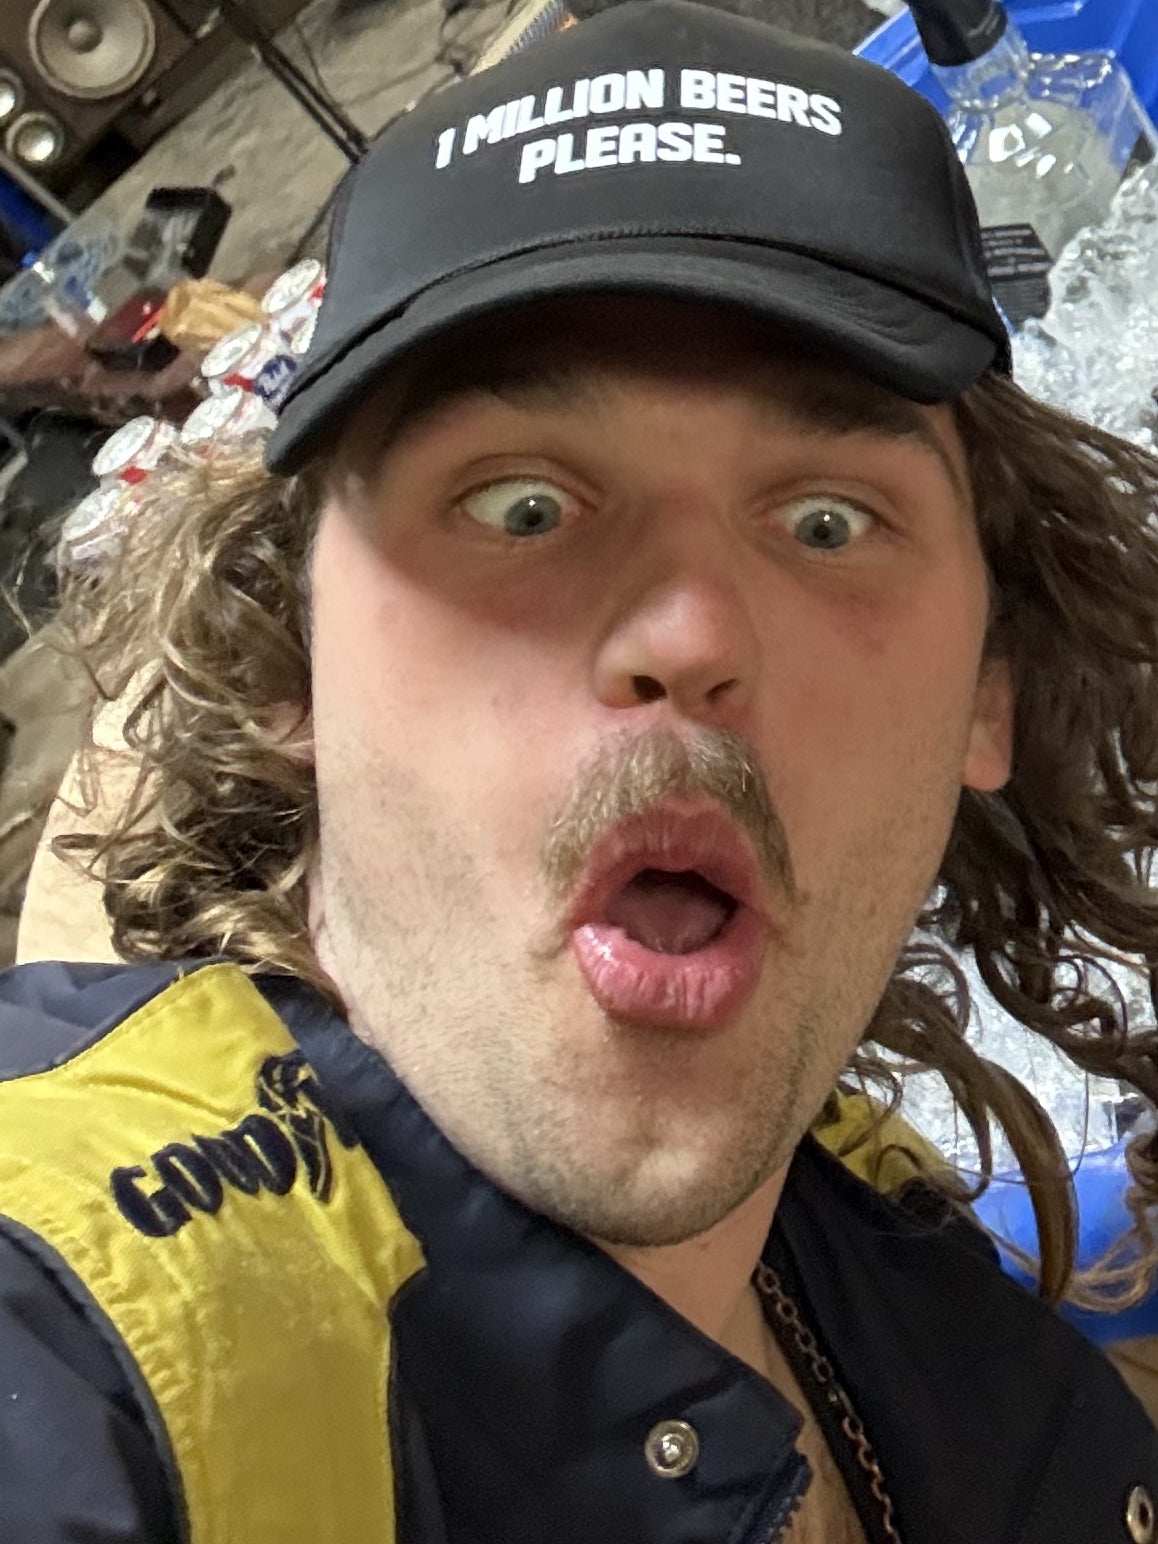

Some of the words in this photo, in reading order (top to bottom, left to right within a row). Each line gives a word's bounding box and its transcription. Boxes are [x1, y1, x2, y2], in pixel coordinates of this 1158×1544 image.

[435, 128, 456, 169] 1
[462, 69, 664, 154] MILLION
[680, 69, 842, 136] BEERS
[518, 122, 742, 183] PLEASE.
